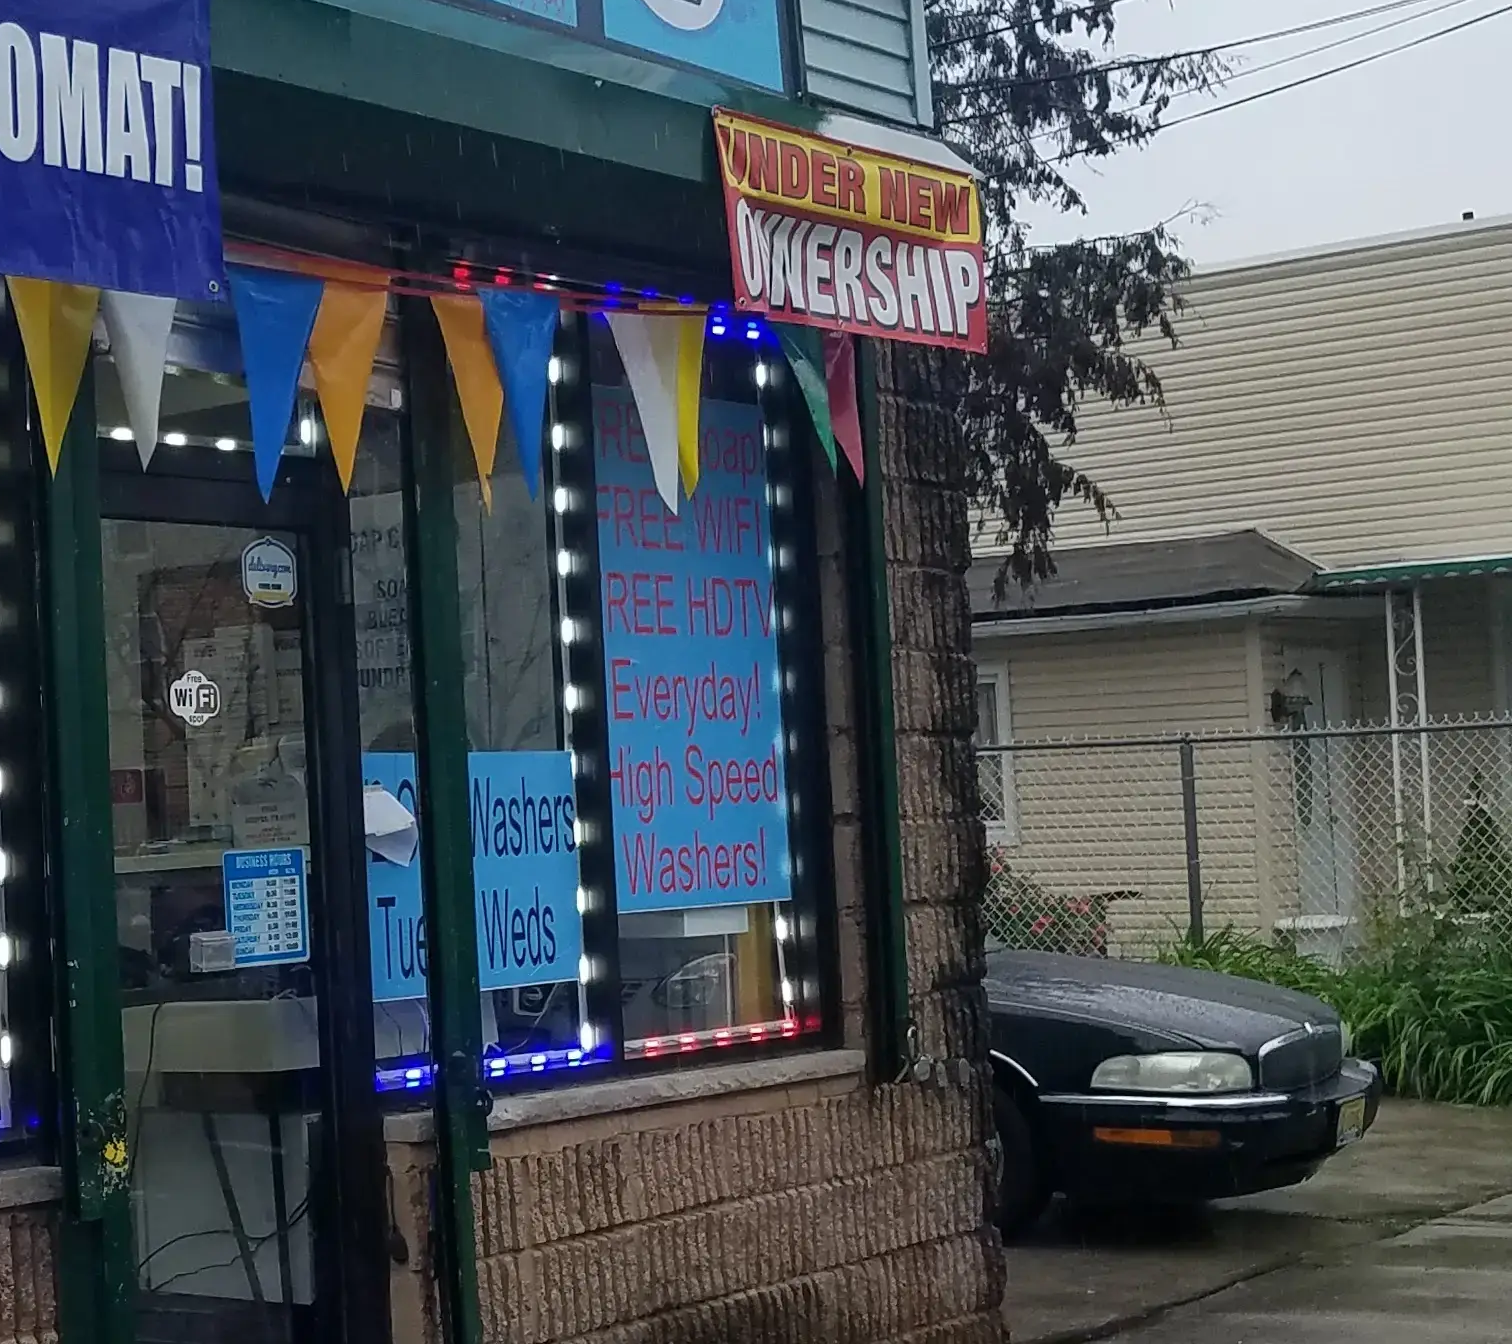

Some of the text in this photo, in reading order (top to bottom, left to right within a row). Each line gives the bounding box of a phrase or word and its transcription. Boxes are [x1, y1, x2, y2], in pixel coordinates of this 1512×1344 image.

[718, 124, 971, 236] UNDER NEW
[700, 420, 765, 488] oap!
[693, 495, 763, 557] WIFI
[686, 576, 775, 638] HDTV
[187, 673, 203, 684] Free
[610, 658, 761, 737] Everyday!
[684, 743, 778, 822] Speed
[621, 826, 767, 896] Washers!
[480, 884, 556, 970] Weds
